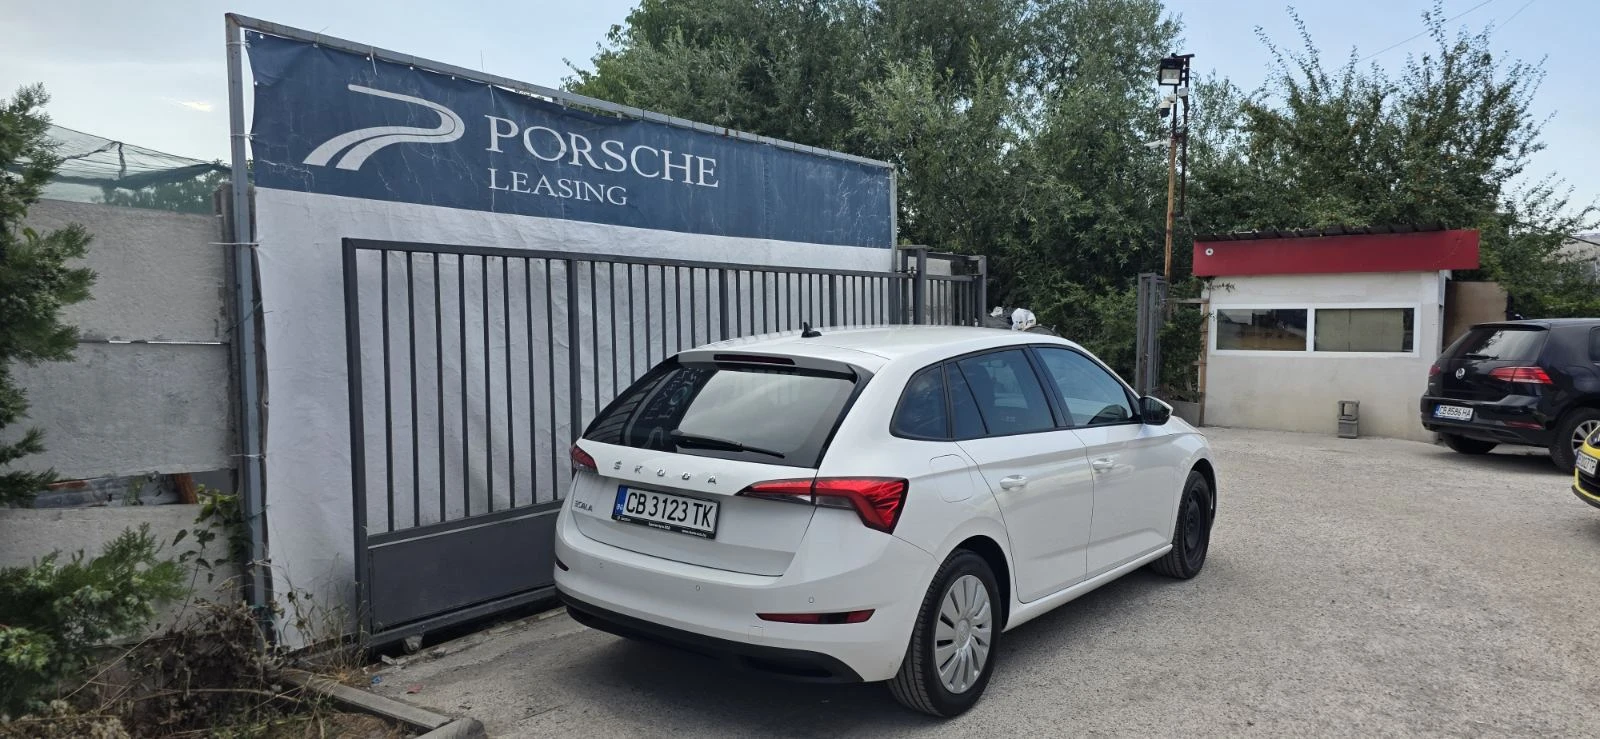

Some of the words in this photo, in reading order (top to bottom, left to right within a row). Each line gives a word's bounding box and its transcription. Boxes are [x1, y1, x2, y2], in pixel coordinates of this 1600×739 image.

[484, 114, 719, 188] PORSCHE
[487, 168, 628, 206] LEASING
[626, 492, 647, 515] CB
[648, 496, 689, 522] 3123
[693, 502, 713, 528] TK
